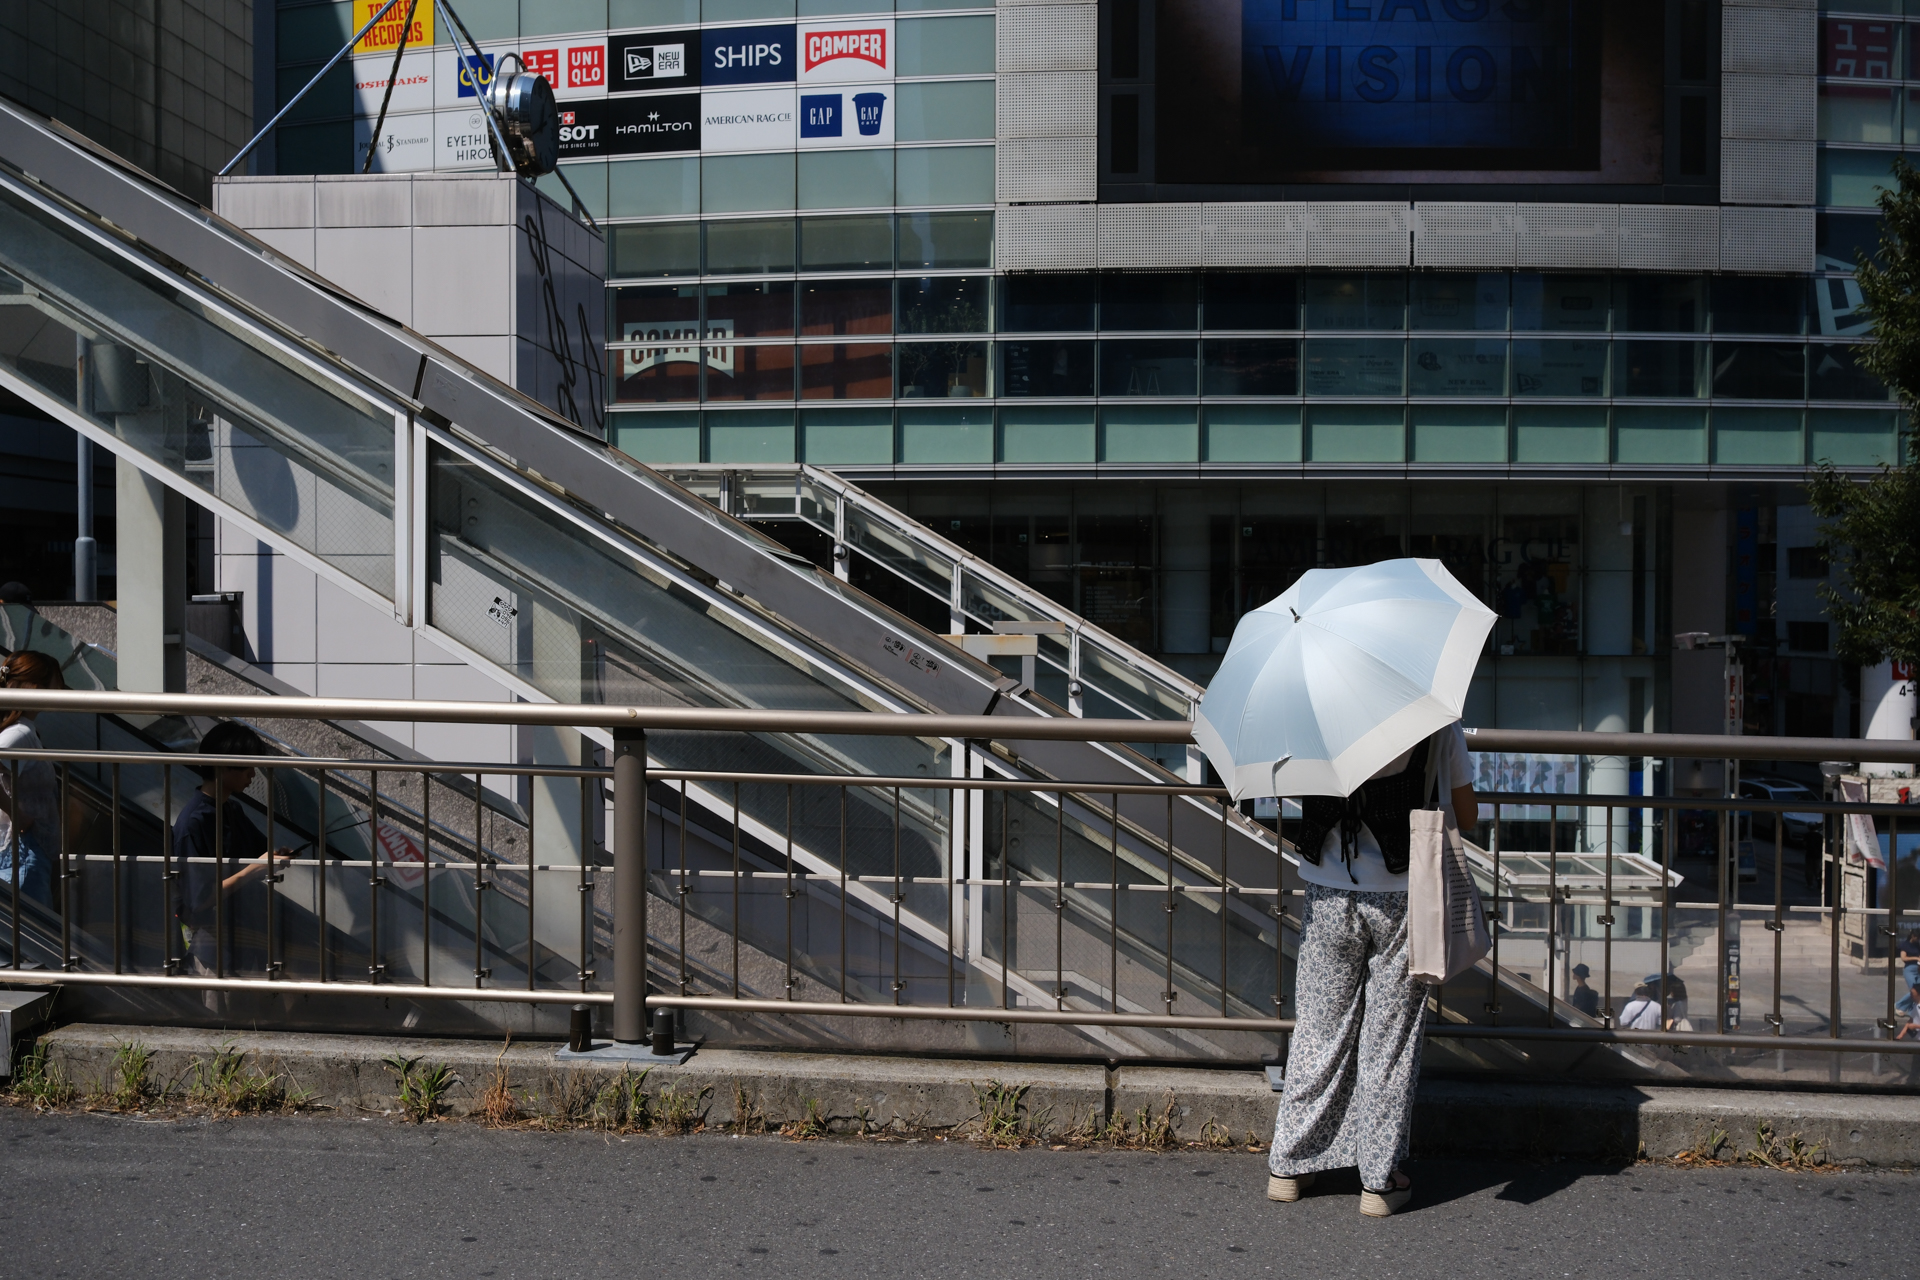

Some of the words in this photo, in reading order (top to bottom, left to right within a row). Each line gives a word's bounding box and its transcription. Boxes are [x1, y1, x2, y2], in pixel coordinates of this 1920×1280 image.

[658, 51, 680, 61] NEW
[714, 43, 782, 69] SHIPS
[809, 33, 882, 63] CAMPER
[571, 50, 599, 66] UNI
[658, 60, 680, 70] ERA
[459, 66, 492, 87] GU
[533, 70, 555, 85] ロ
[571, 67, 601, 85] QLO
[1262, 44, 1558, 104] VISION
[705, 113, 755, 126] AMERICAN
[756, 113, 777, 124] RAG
[810, 106, 834, 125] GAP
[860, 106, 880, 121] GAP
[559, 125, 600, 142] SOT
[616, 120, 693, 135] HAMILTON
[396, 137, 429, 147] STANDARD
[447, 133, 487, 148] EYETHI
[630, 327, 726, 364] CAMPR
